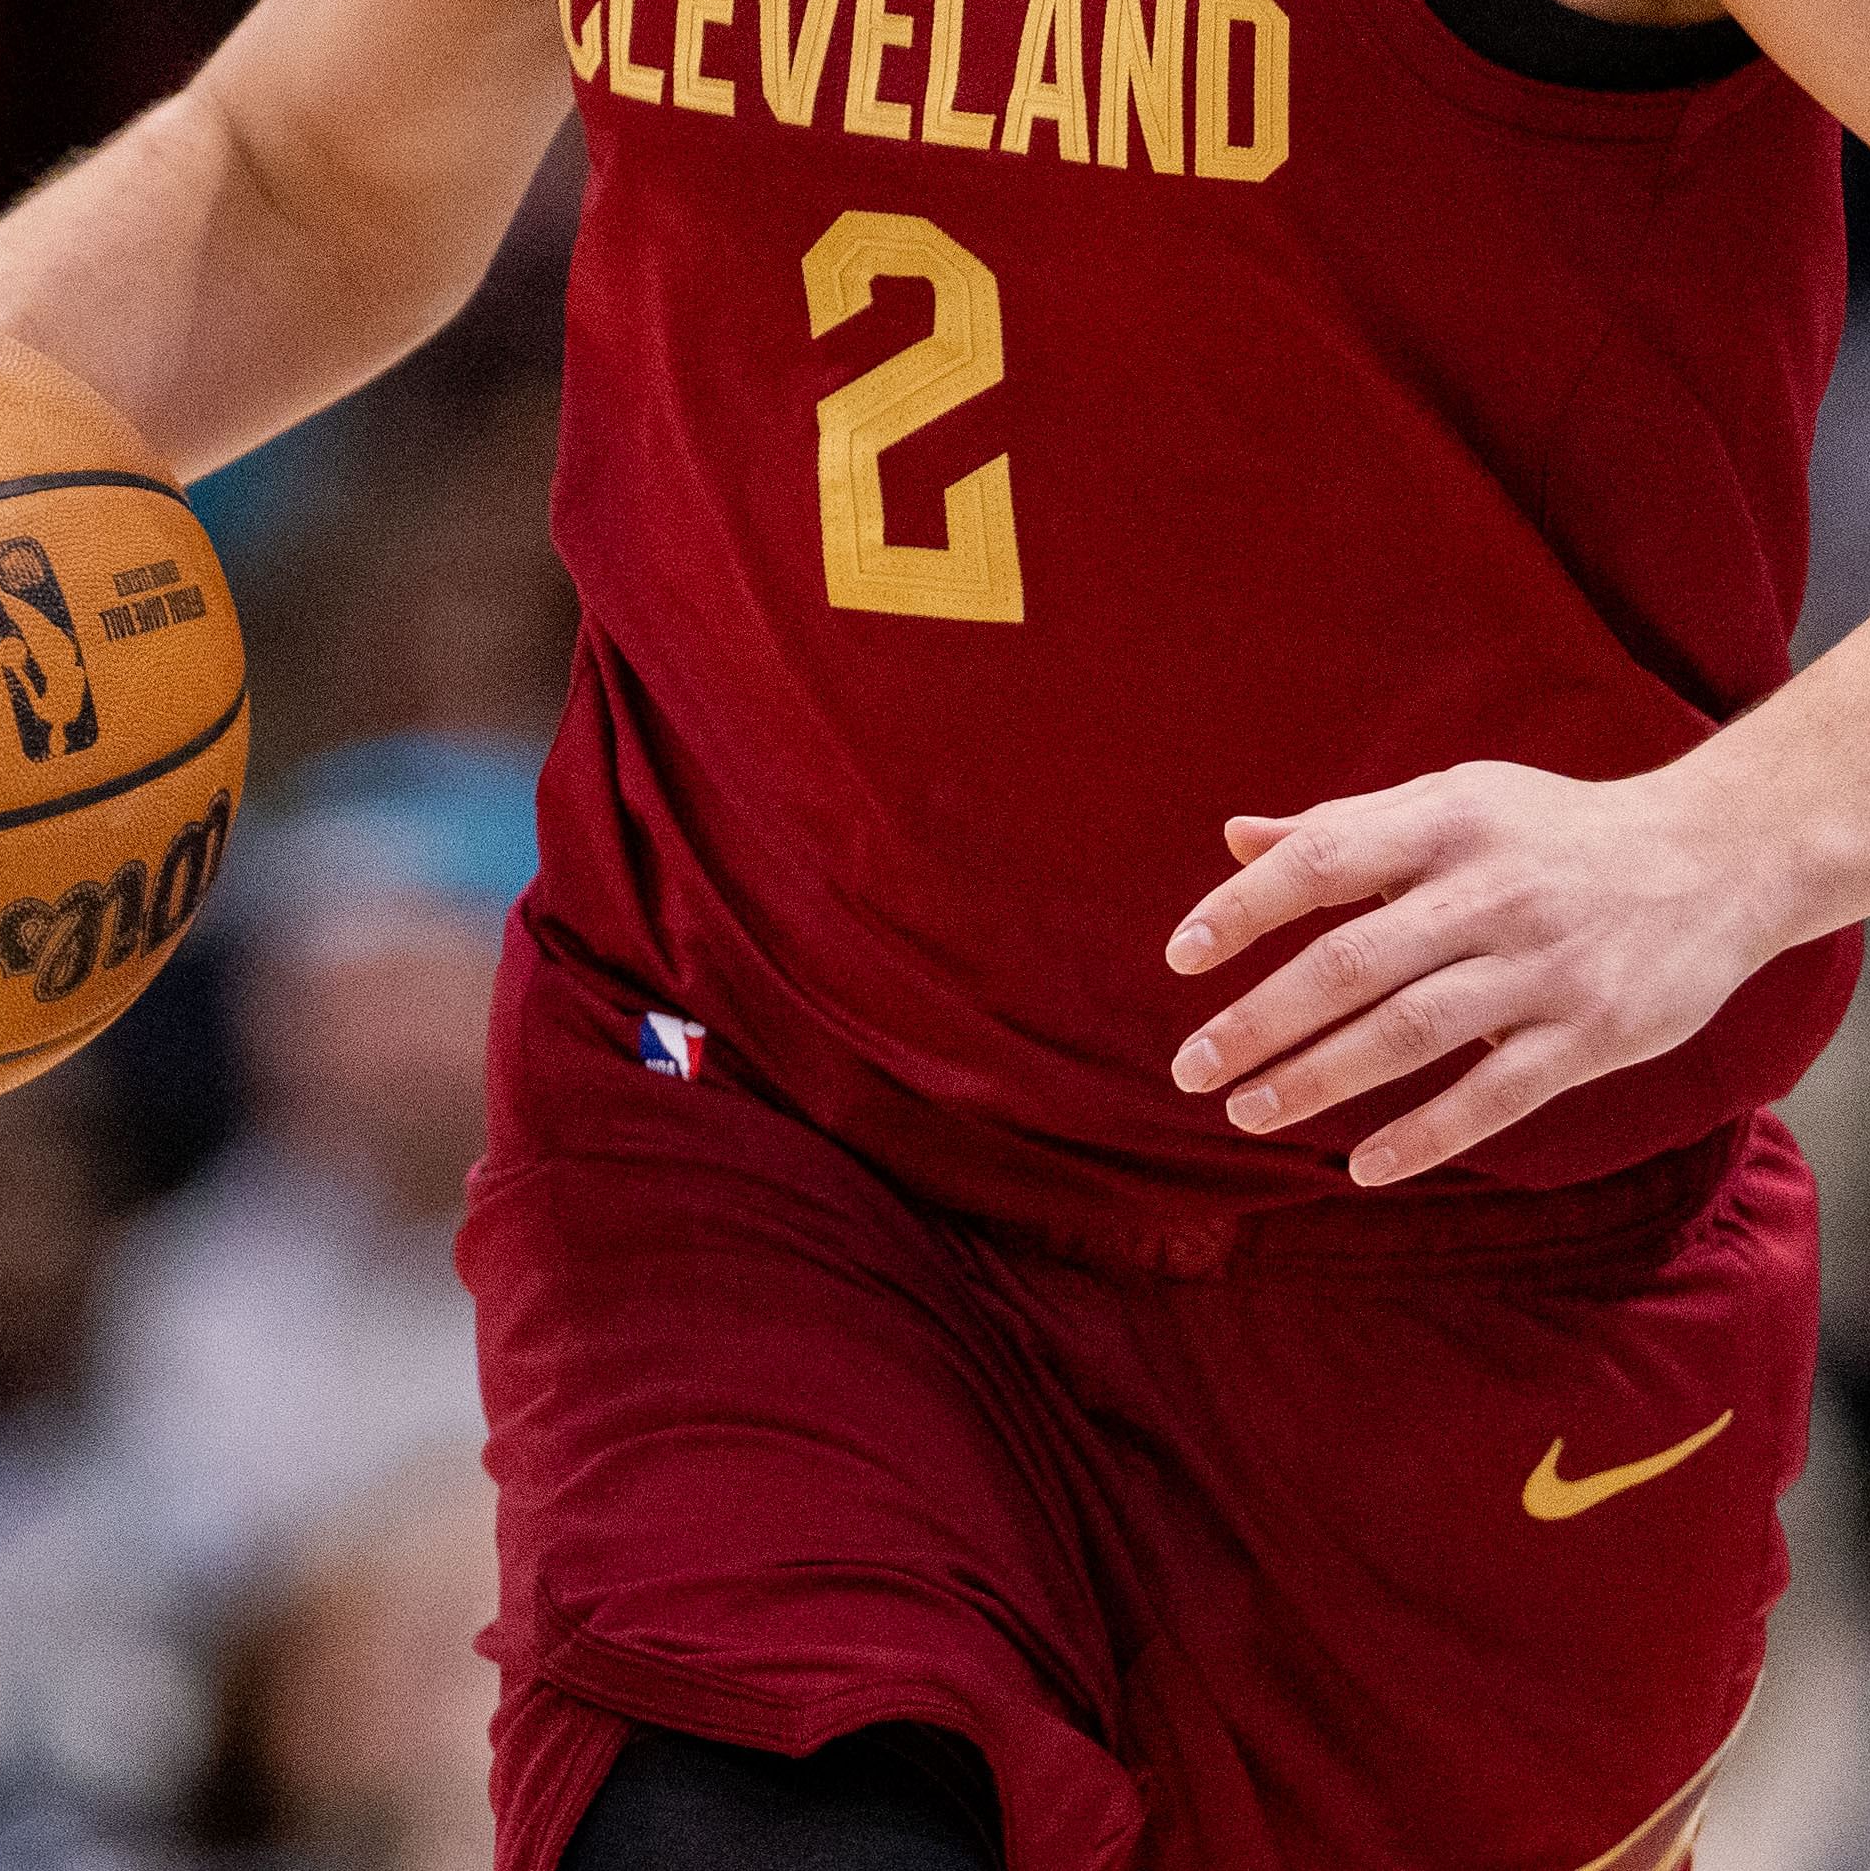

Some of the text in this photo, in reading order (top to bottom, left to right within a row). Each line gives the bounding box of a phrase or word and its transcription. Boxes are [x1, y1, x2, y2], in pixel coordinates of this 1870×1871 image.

[801, 209, 1025, 625] 2
[98, 603, 137, 643] BALL
[131, 596, 169, 635] GAME
